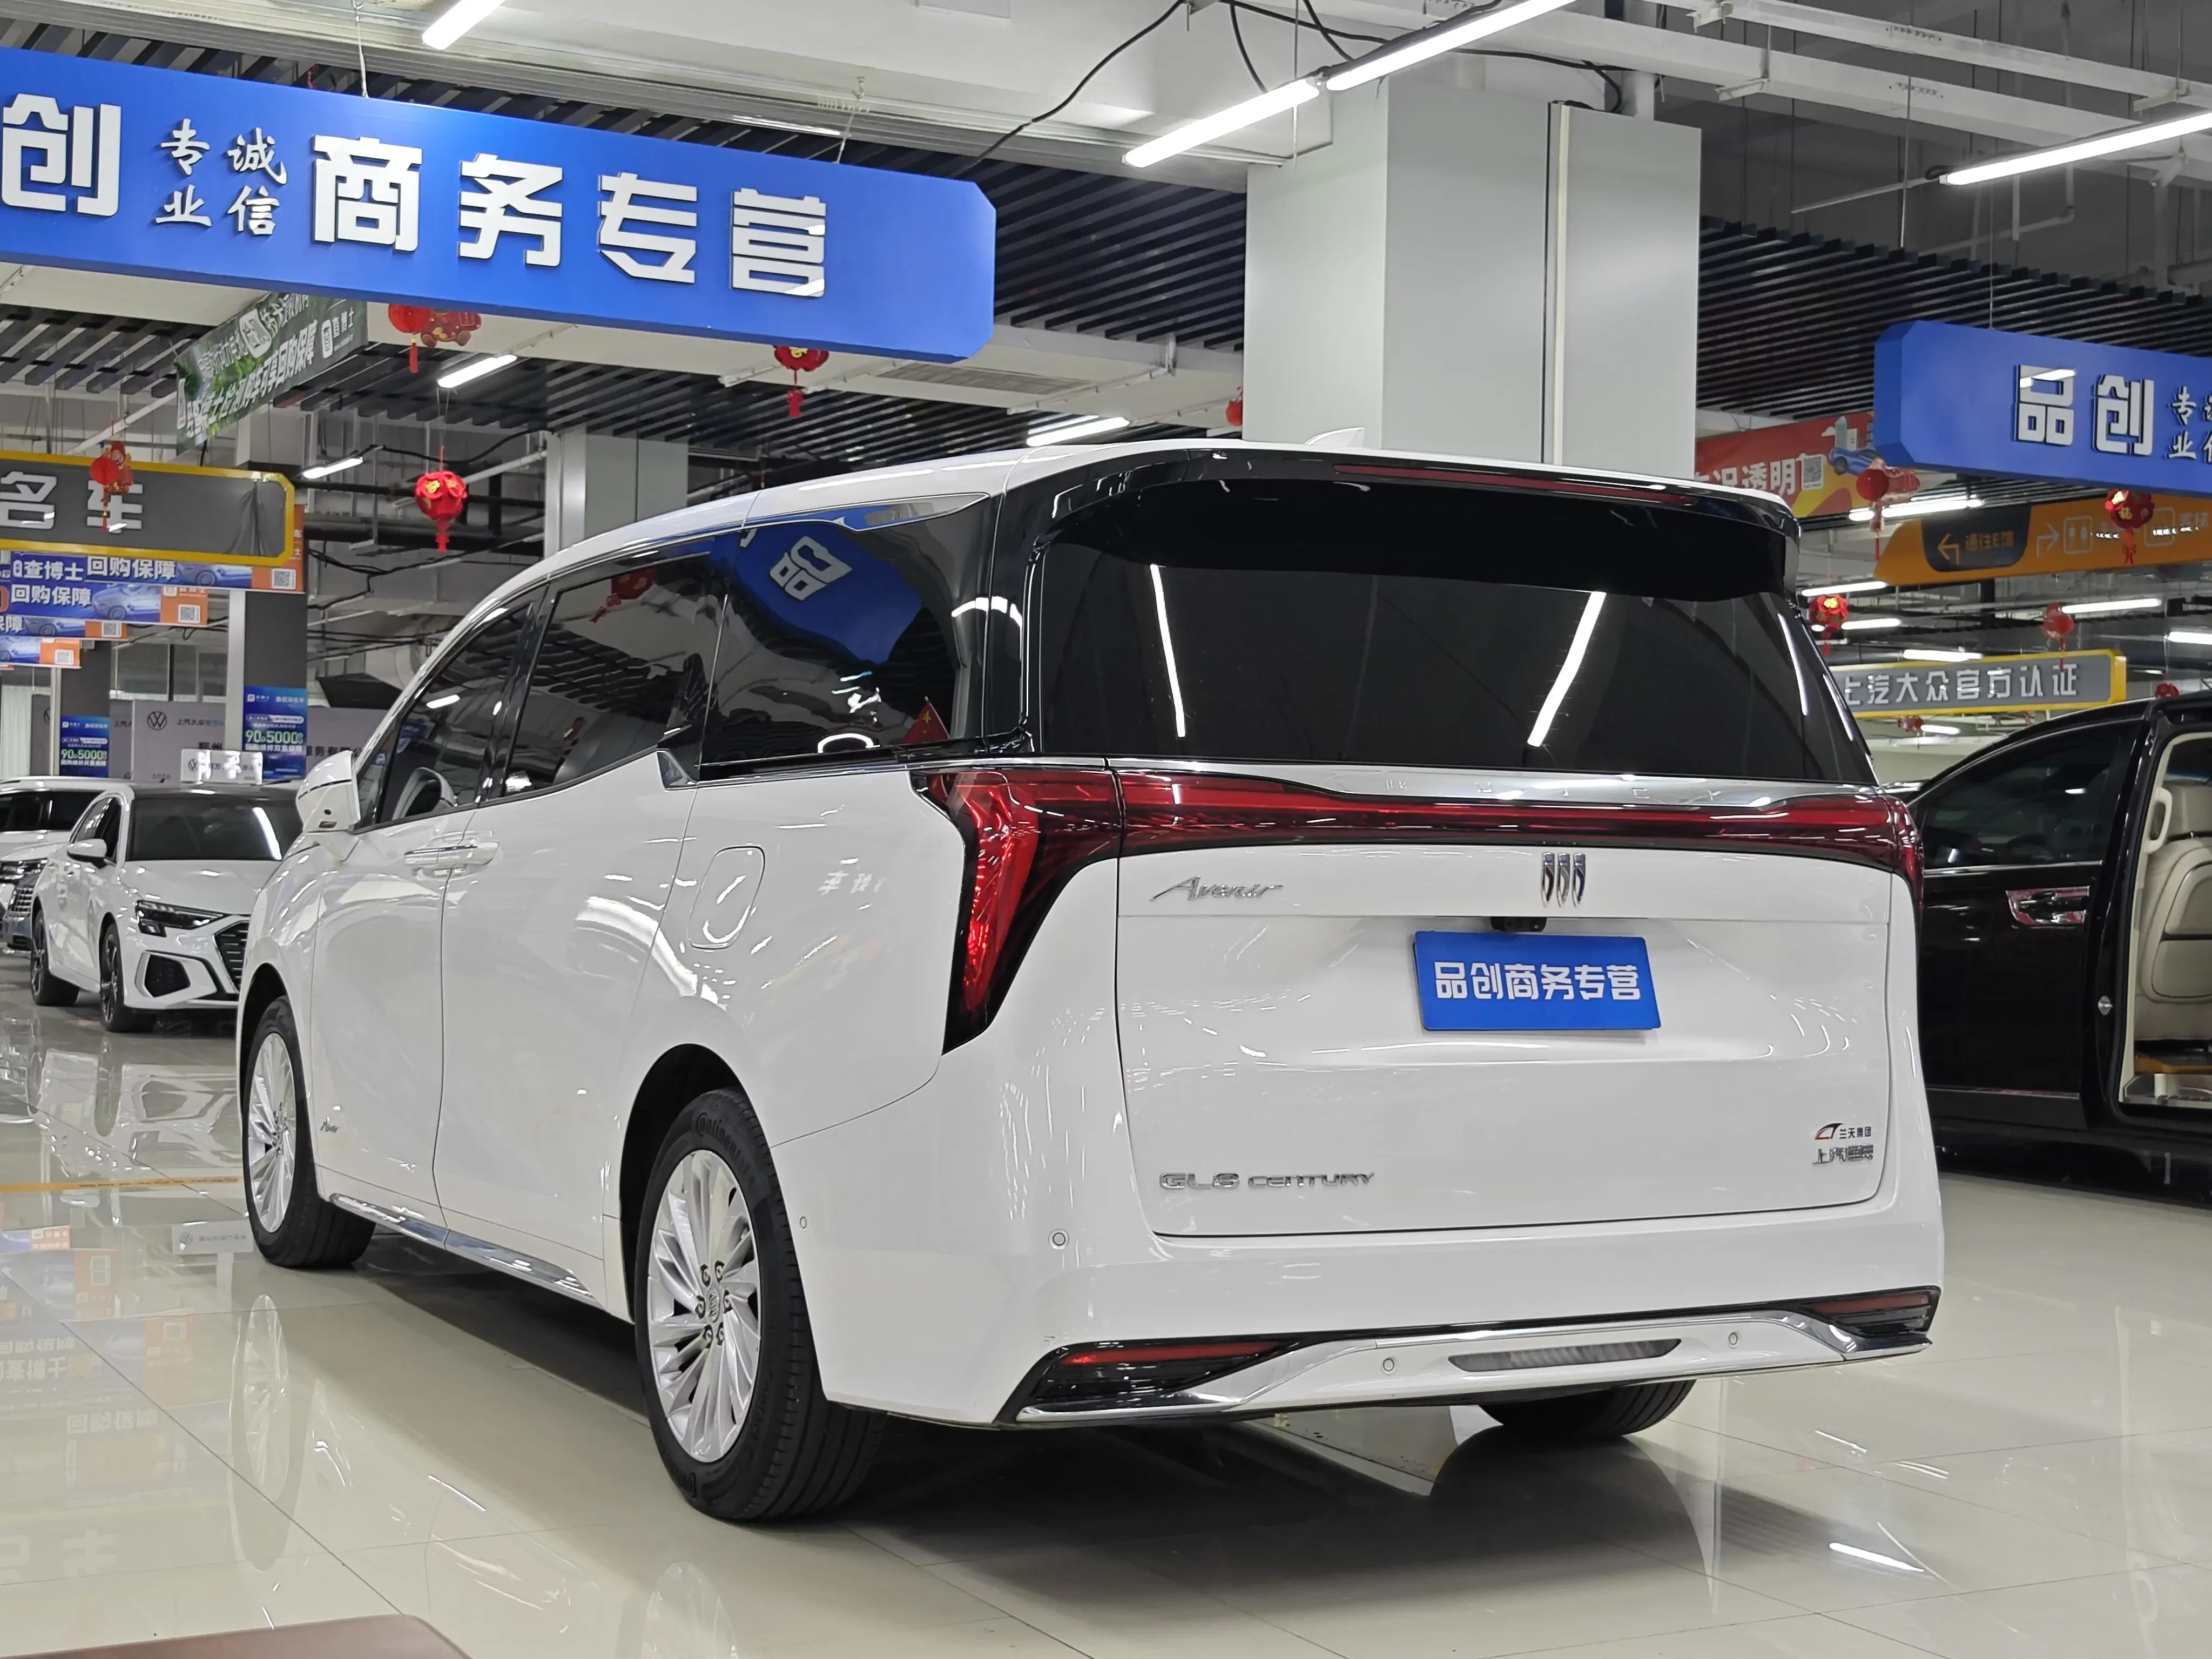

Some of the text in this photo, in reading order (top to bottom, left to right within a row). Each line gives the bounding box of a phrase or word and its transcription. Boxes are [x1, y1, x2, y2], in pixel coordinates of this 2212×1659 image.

[312, 135, 826, 298] 商务专营
[2013, 363, 2155, 457] 品创
[0, 470, 144, 534] 名车
[24, 559, 84, 581] 查博士
[86, 555, 177, 580] 回购保障
[11, 584, 92, 608] 回购保障
[1844, 662, 2078, 705] 上汽大众官方认证
[1149, 874, 1283, 902] Avenir
[1434, 961, 1641, 1001] 品创商务专营
[1159, 1171, 1240, 1190] GL8
